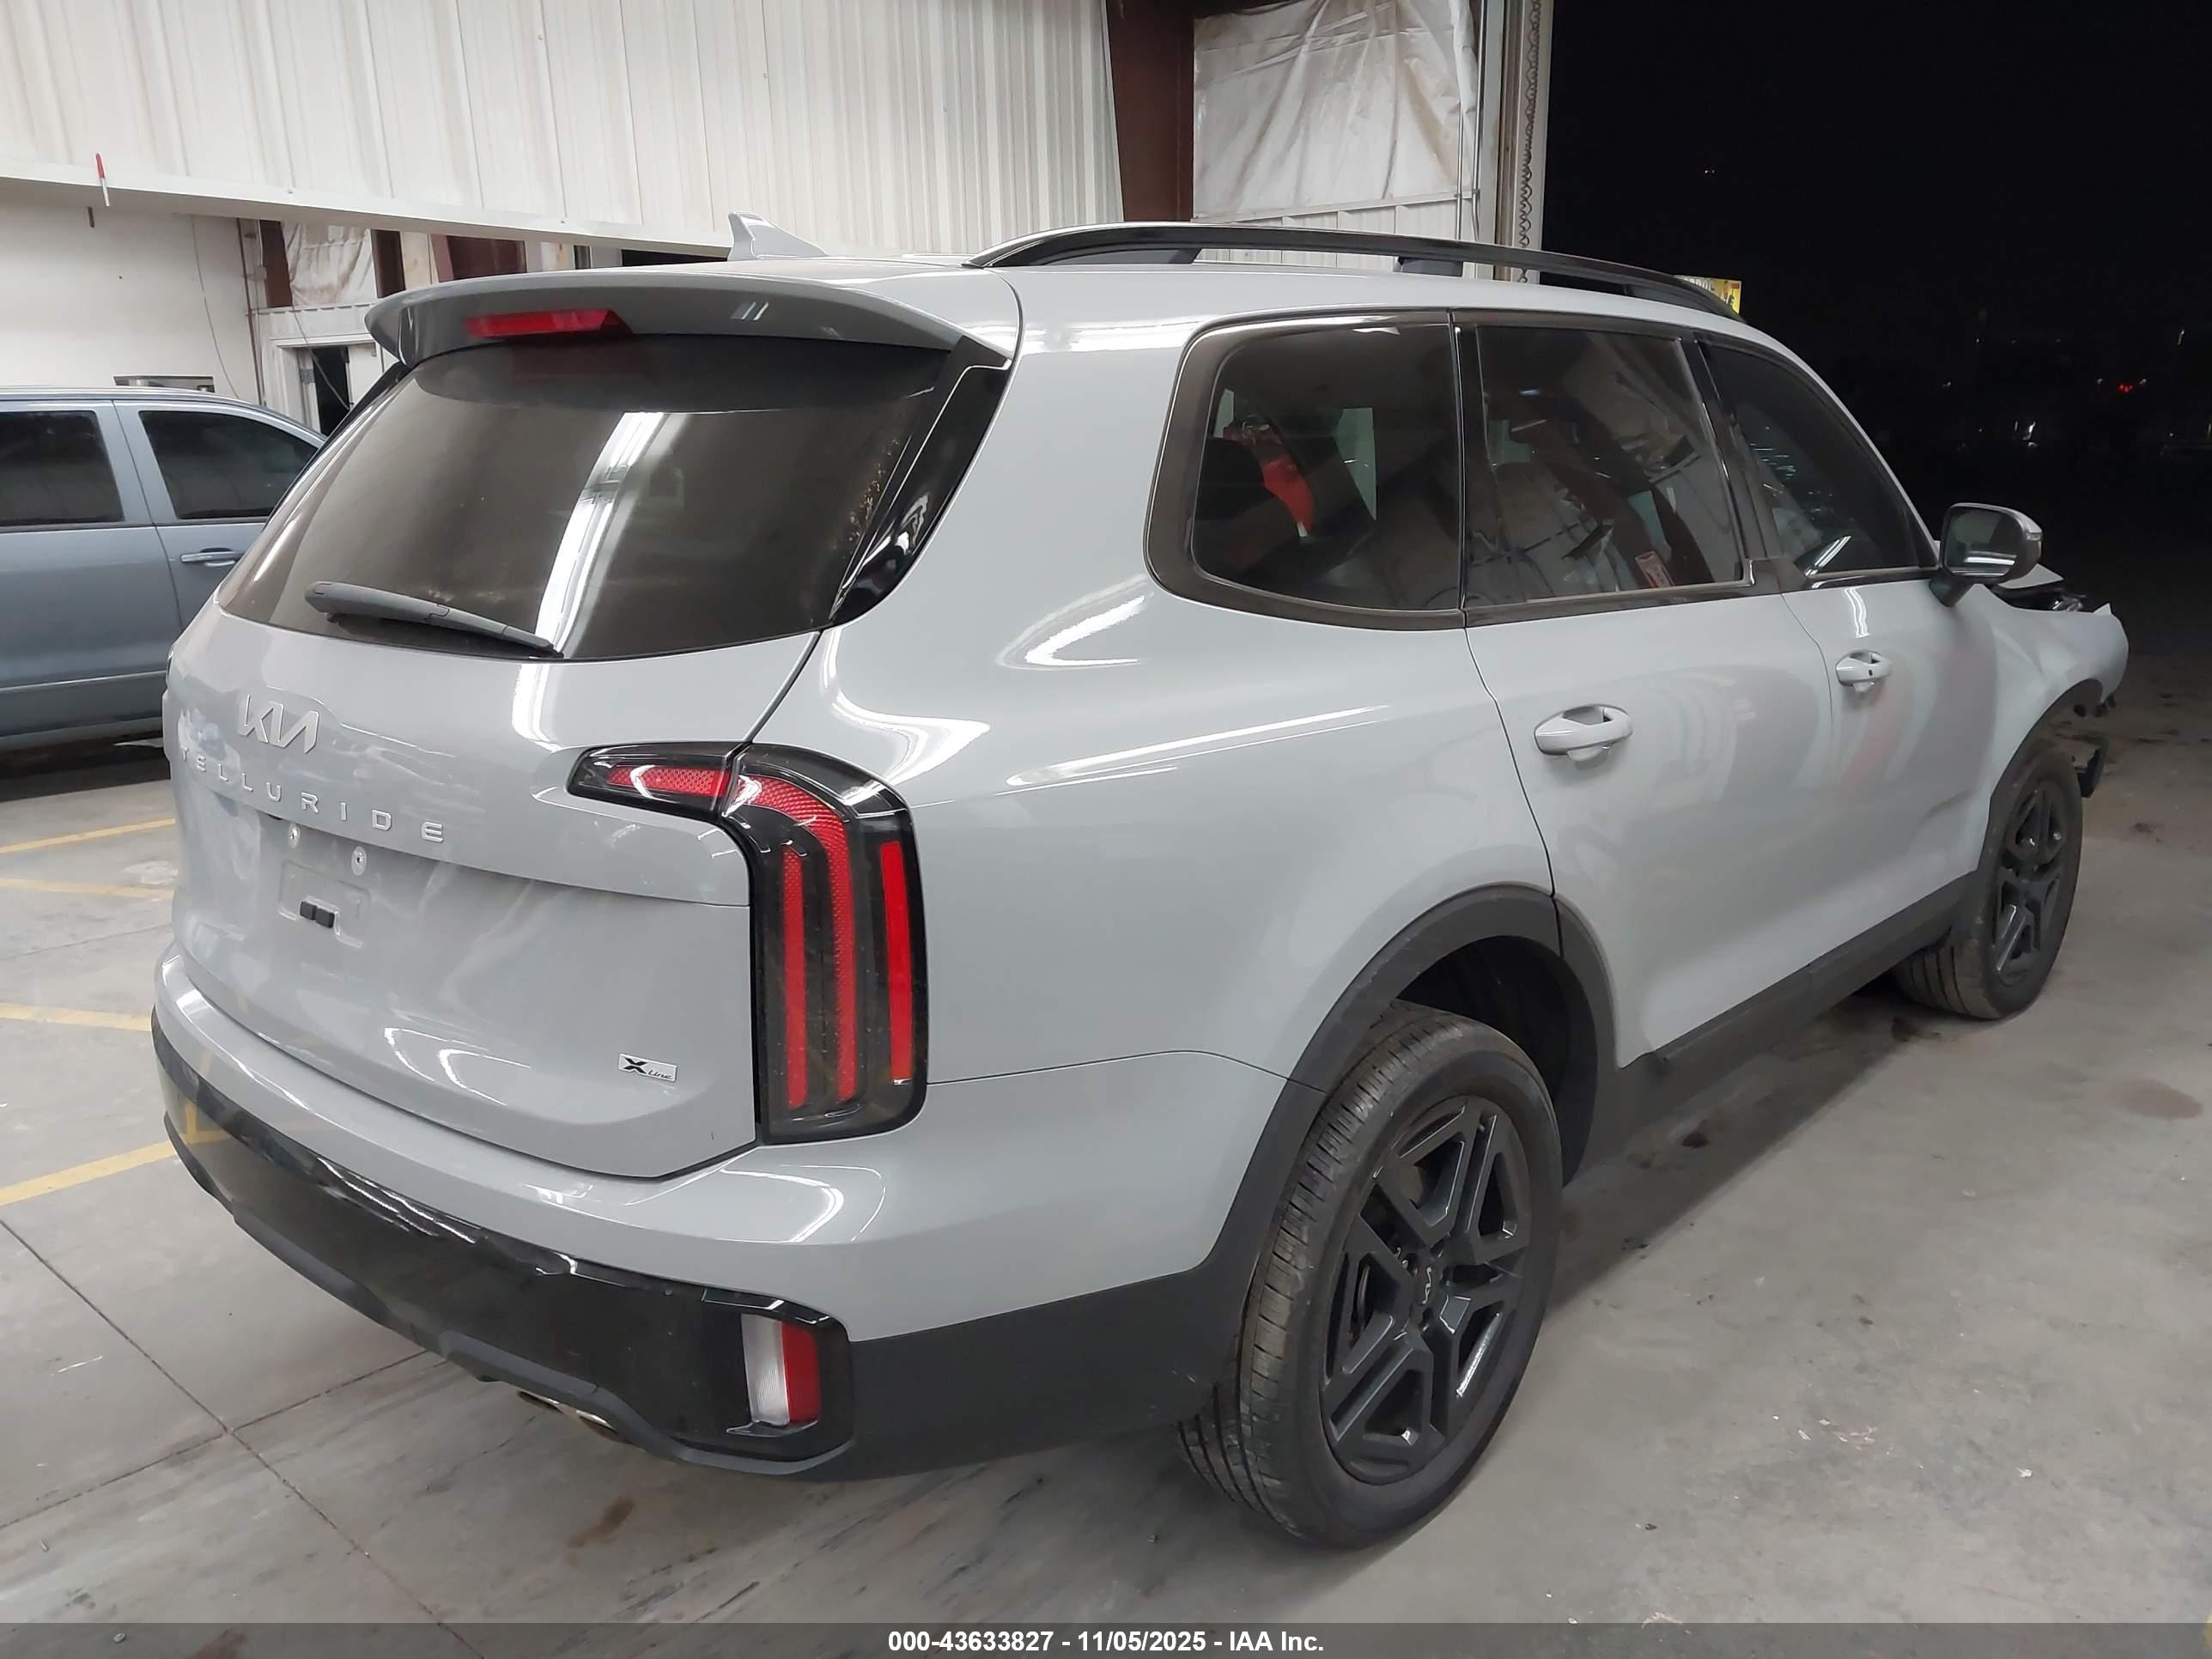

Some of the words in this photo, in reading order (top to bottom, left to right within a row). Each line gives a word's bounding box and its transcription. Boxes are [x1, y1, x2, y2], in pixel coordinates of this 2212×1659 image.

[236, 694, 319, 754] KIA
[180, 746, 445, 843] TELLURIDE
[622, 1056, 648, 1075] X
